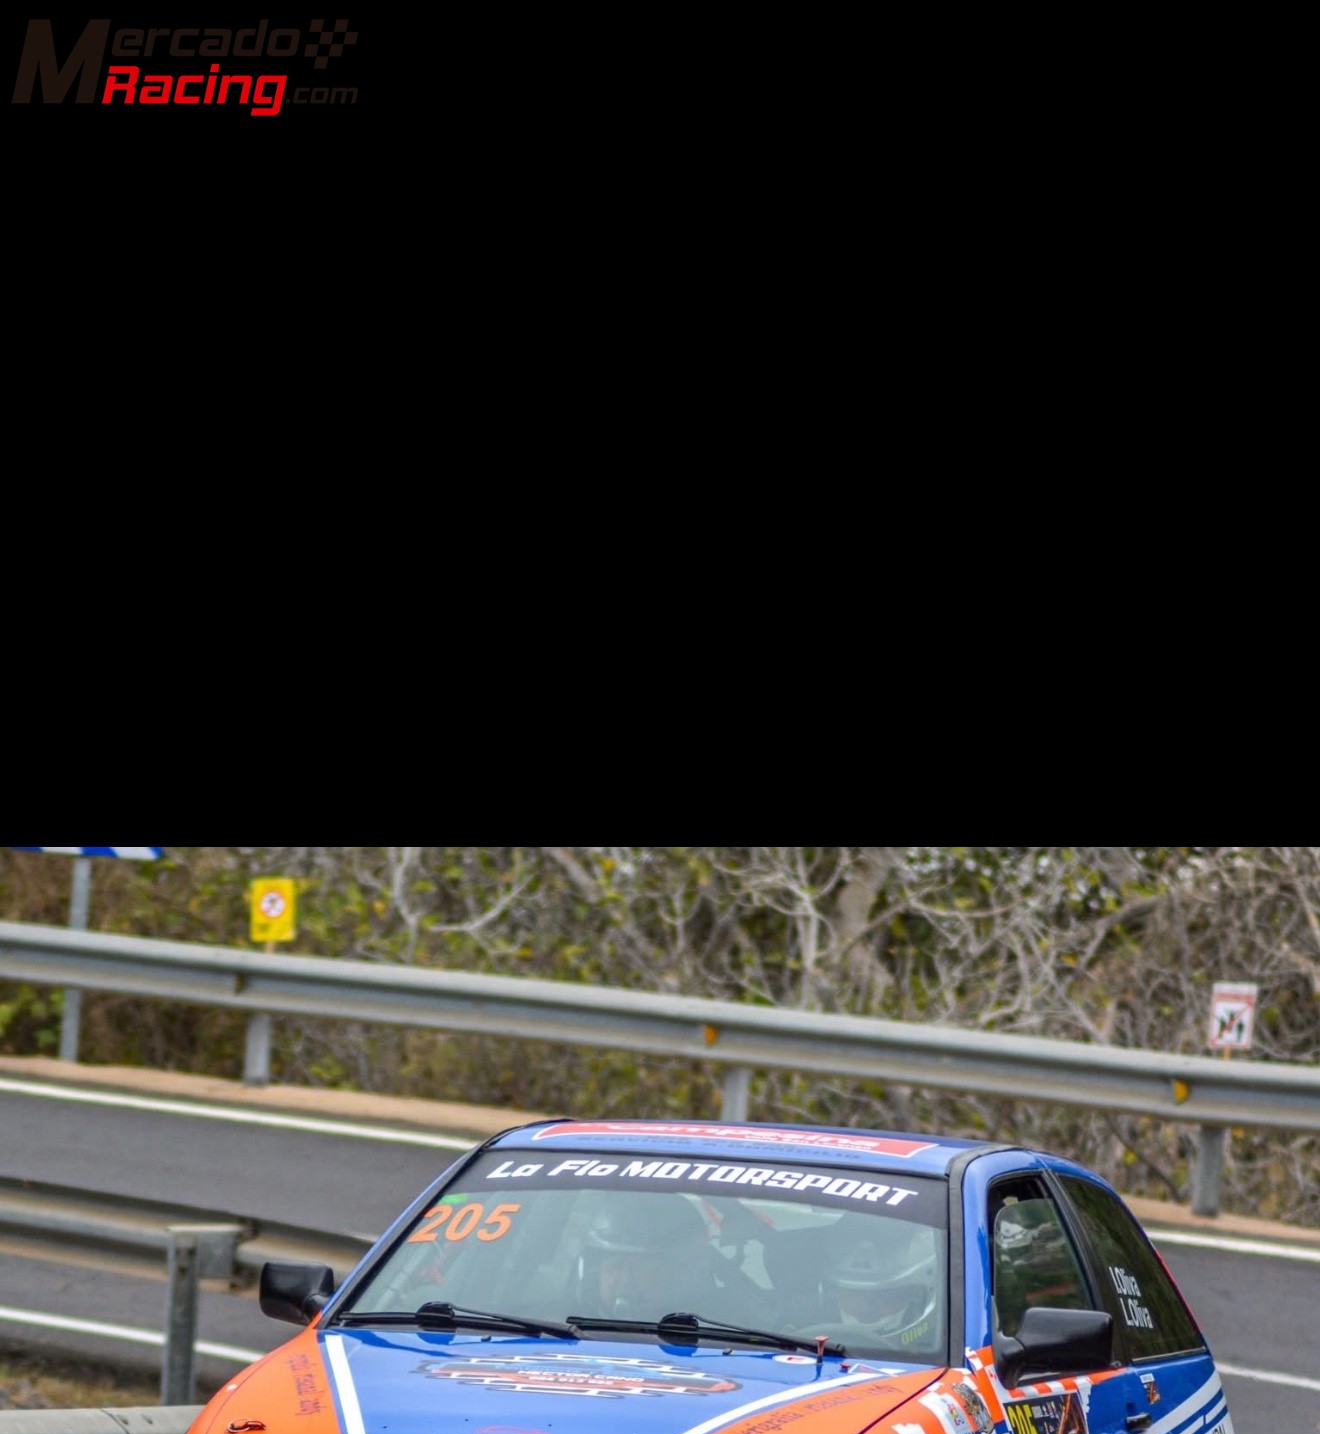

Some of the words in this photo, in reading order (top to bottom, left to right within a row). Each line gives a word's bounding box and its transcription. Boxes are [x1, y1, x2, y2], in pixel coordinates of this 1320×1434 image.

[486, 1161, 544, 1179] La
[547, 1159, 620, 1177] Flo
[619, 1160, 919, 1206] MOTORSPORT
[407, 1202, 522, 1244] 205
